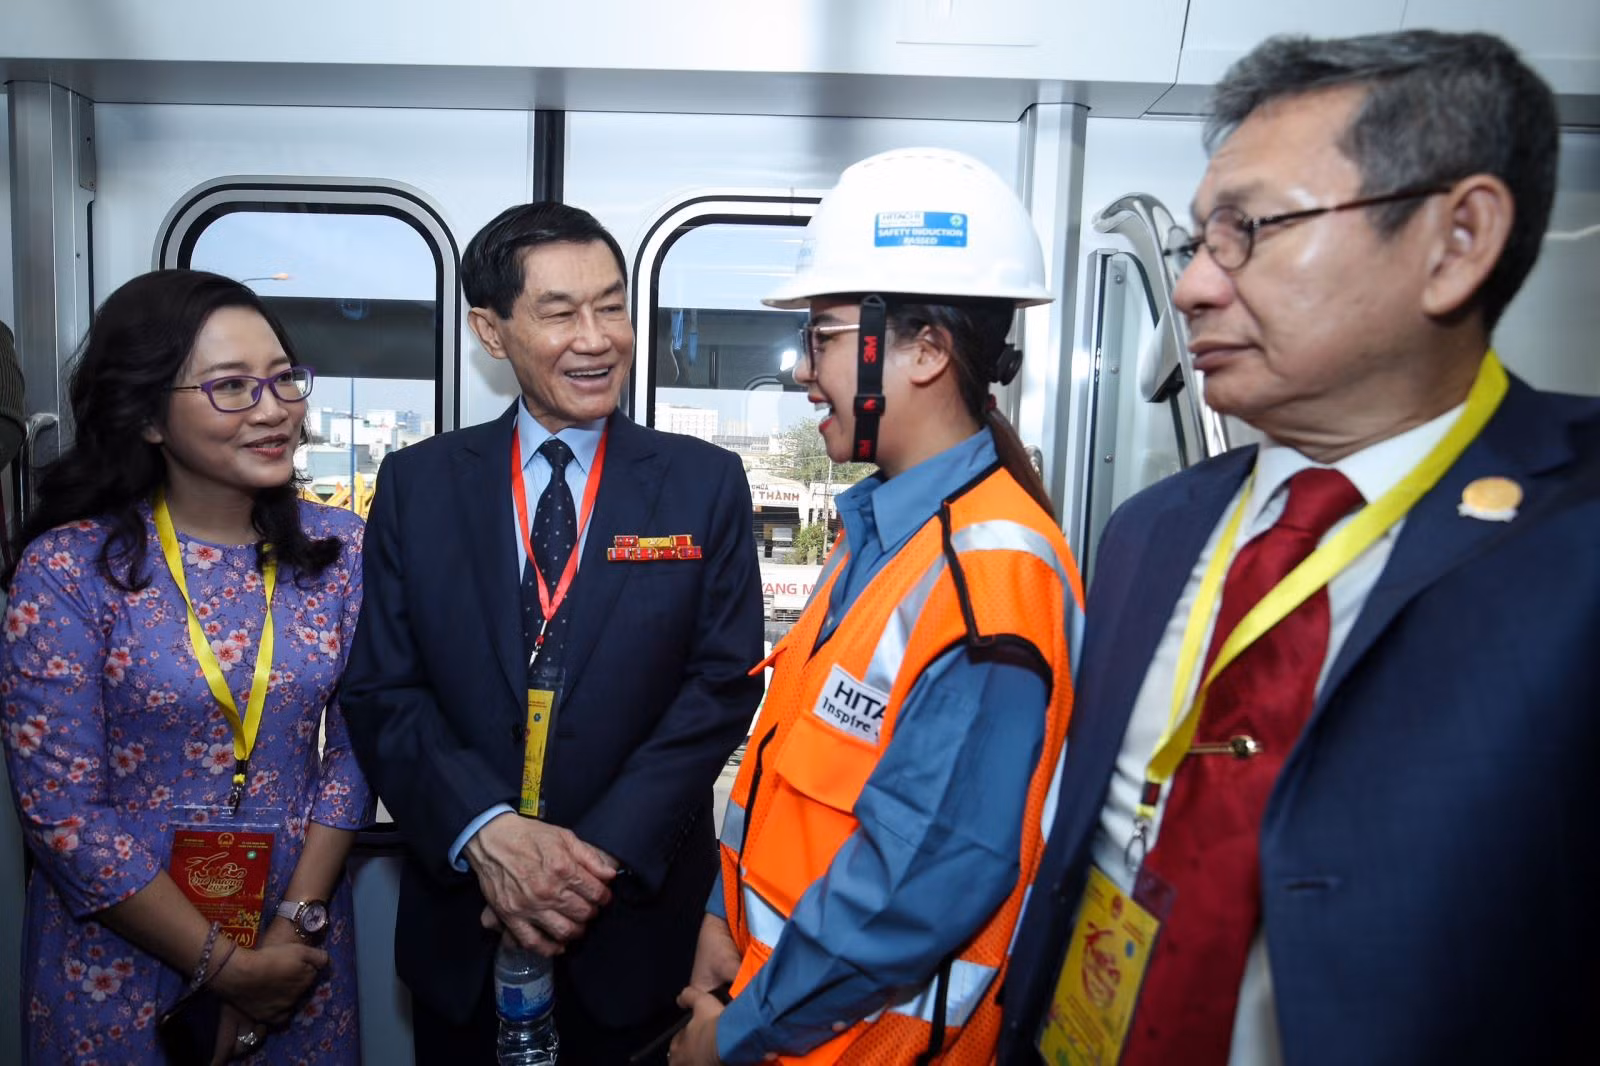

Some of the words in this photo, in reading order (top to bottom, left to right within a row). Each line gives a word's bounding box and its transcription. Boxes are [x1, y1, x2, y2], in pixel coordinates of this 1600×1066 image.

[879, 228, 912, 237] SAFETY
[913, 228, 963, 238] INDUCTION
[903, 236, 938, 246] PASSED
[864, 335, 878, 364] 3M
[759, 490, 800, 501] THÀNH
